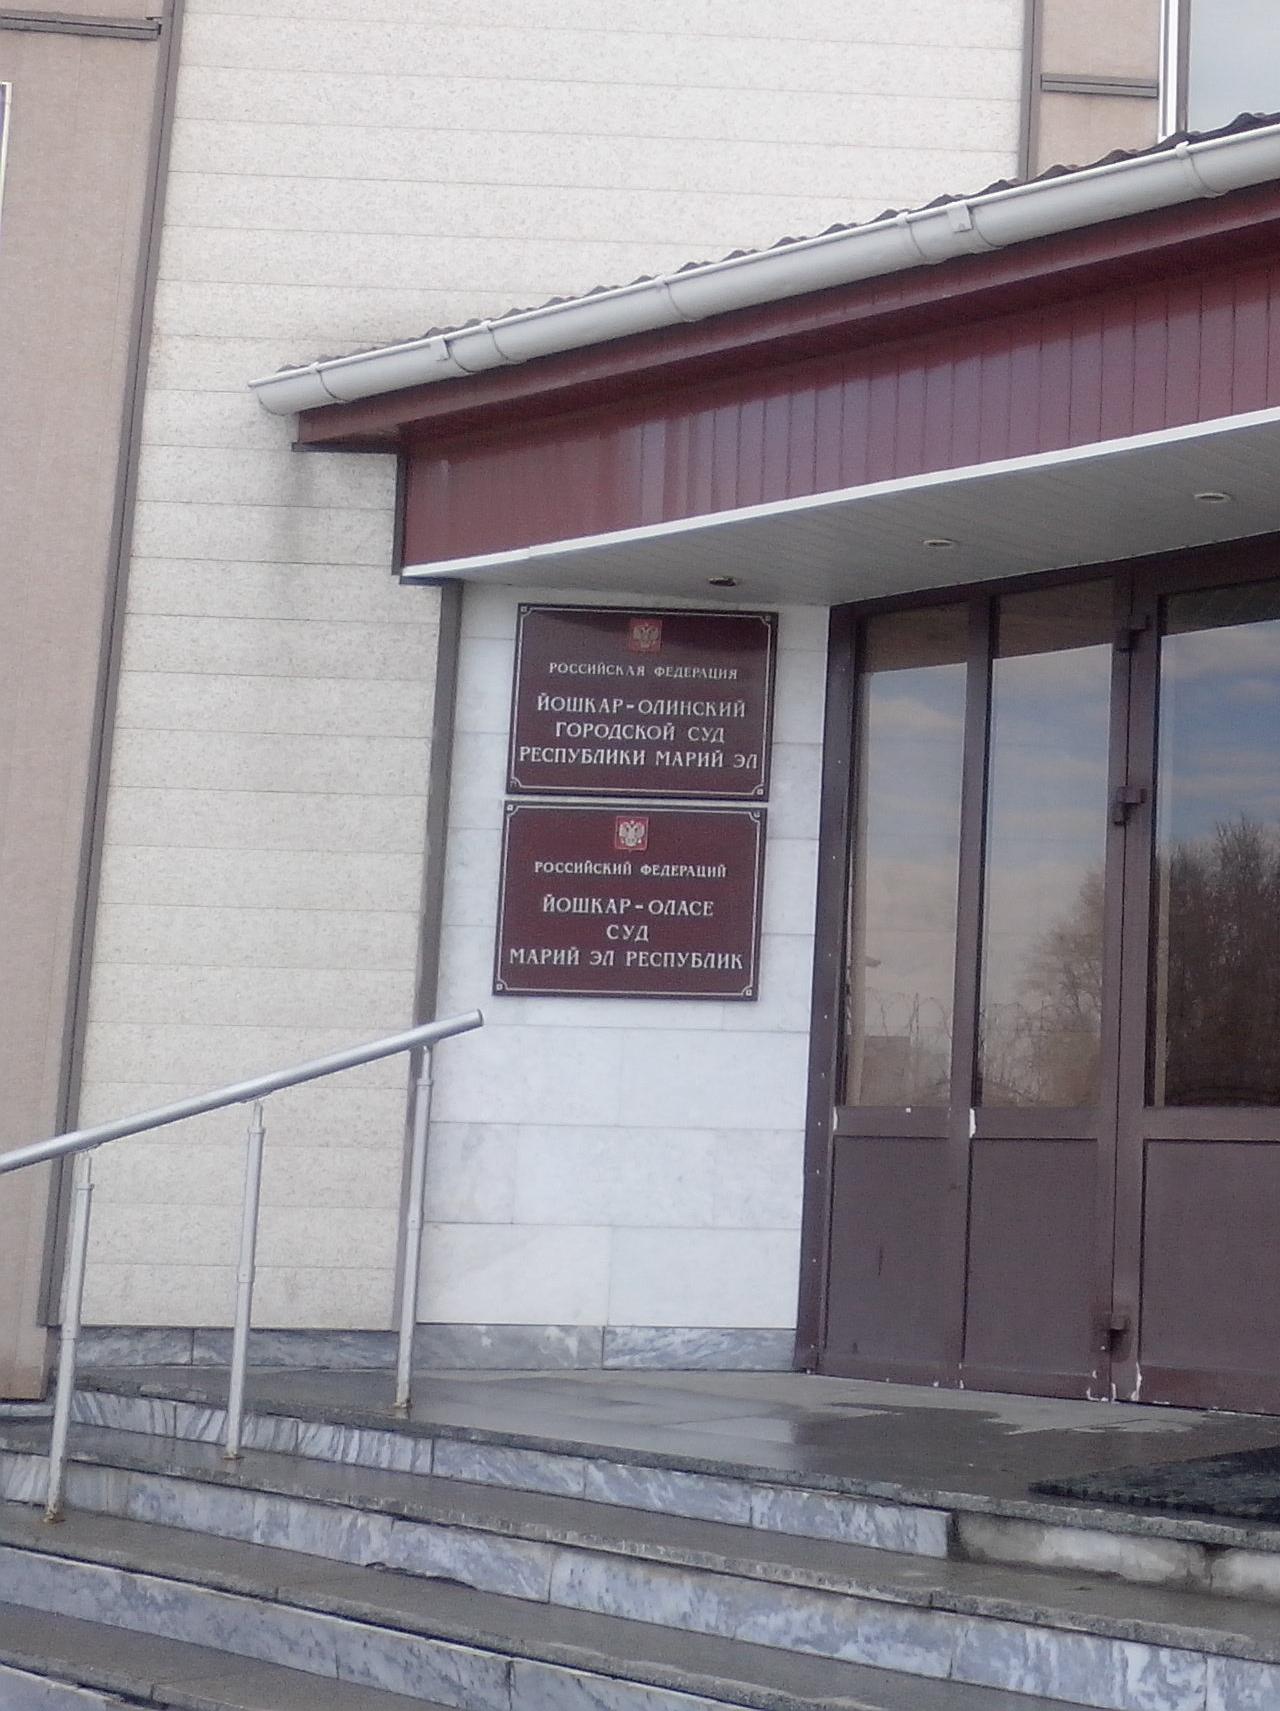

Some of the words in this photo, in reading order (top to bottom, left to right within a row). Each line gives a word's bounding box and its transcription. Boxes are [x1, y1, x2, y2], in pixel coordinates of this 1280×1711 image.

[550, 661, 645, 677] РОССИЙСКАЯ
[654, 665, 738, 680] ФЕДЕРАЦИЯ
[537, 692, 745, 718] ЙОШКАР-ОЛИНСКИЙ
[555, 721, 675, 741] ГОРОДСКОЙ
[687, 726, 725, 744] СУД
[519, 746, 645, 766] РЕСПУБЛИКИ
[655, 750, 723, 768] МАРИЙ
[733, 754, 758, 770] ЭЛ
[534, 860, 632, 876] РОССИЙСКИЙ
[640, 863, 727, 878] ФЕДЕРАЦИЙ
[543, 894, 714, 917] ЙОШКАР-ОЛАСЕ
[606, 924, 649, 942] СУД
[509, 947, 580, 966] МАРИЙ
[590, 950, 614, 967] ЭЛ
[626, 951, 743, 970] РЕСПУБЛИК
